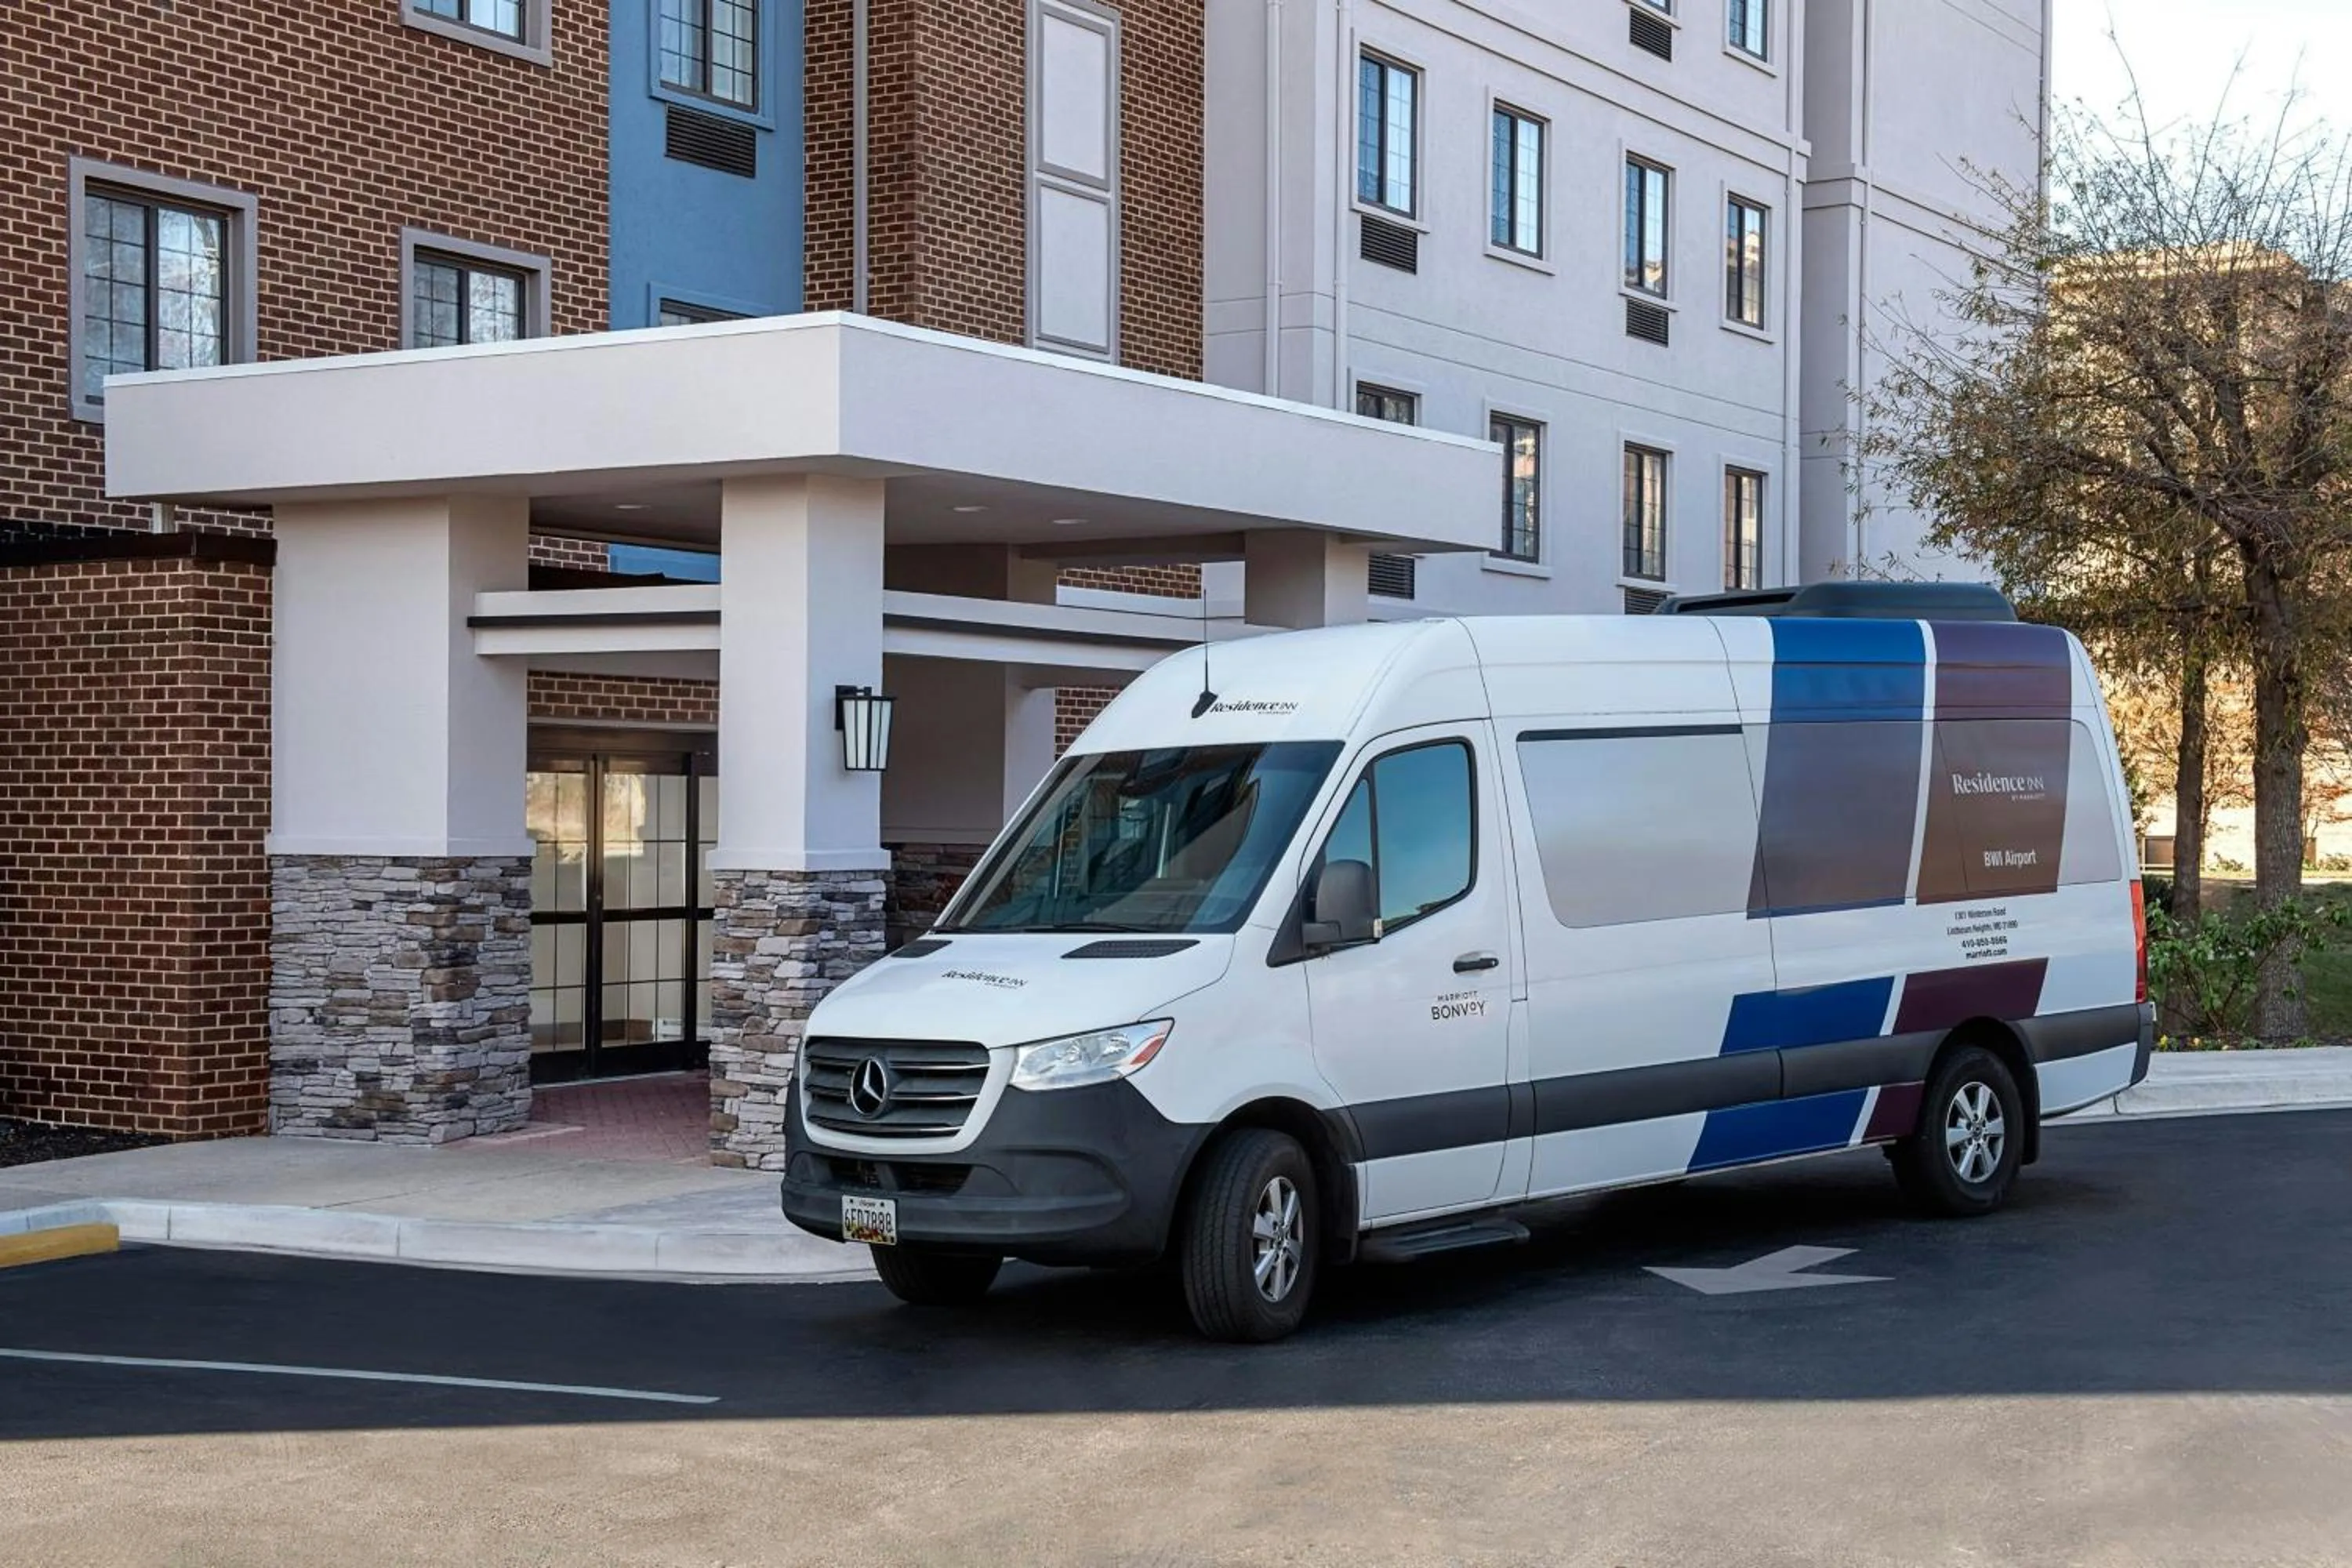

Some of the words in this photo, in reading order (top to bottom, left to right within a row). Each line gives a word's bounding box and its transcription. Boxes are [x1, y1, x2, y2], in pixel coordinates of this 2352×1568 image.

[1210, 700, 1279, 713] Residence
[1952, 772, 2025, 795] Residence
[1984, 851, 2003, 866] BWI
[2005, 848, 2037, 869] Airport
[1431, 1000, 1486, 1020] BONVOY
